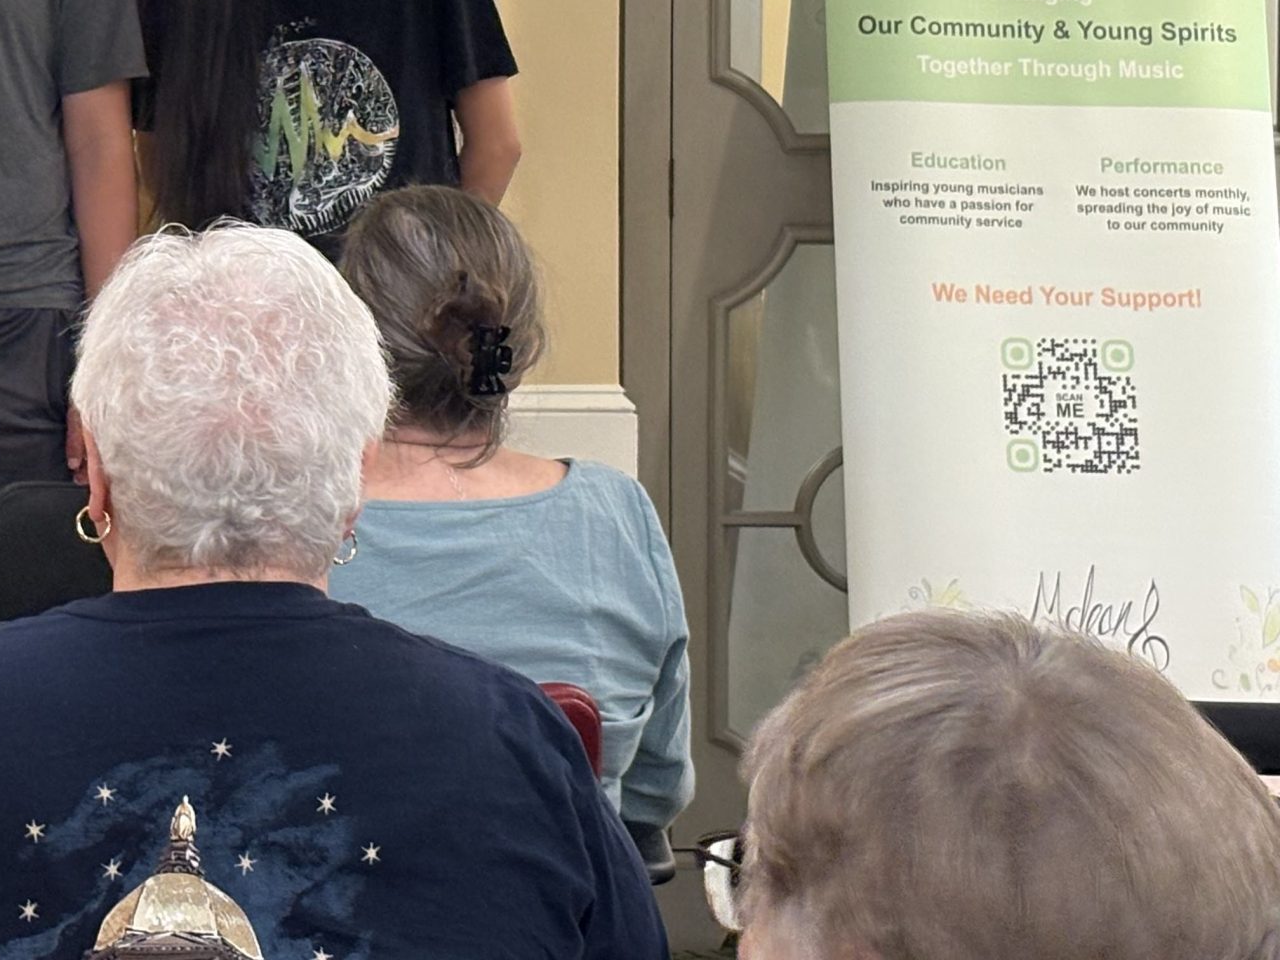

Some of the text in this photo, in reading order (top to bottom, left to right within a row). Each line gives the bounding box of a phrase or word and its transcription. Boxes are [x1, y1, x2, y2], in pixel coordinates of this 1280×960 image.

[858, 16, 1237, 46] Our Community & Young Spirits
[916, 55, 1184, 82] Together Through Music
[911, 151, 1007, 171] Education
[1100, 157, 1224, 175] Performance
[871, 180, 1044, 196] Inspiring young musicians
[1076, 185, 1250, 202] We host concerts monthly,
[883, 197, 1034, 212] who have a passion for
[1077, 203, 1251, 217] spreading the joy of music
[899, 214, 1023, 229] community service
[1107, 219, 1224, 234] to our community
[932, 282, 1202, 312] We Need Your Support!
[1056, 393, 1083, 402] SCAN
[1056, 403, 1085, 418] ME
